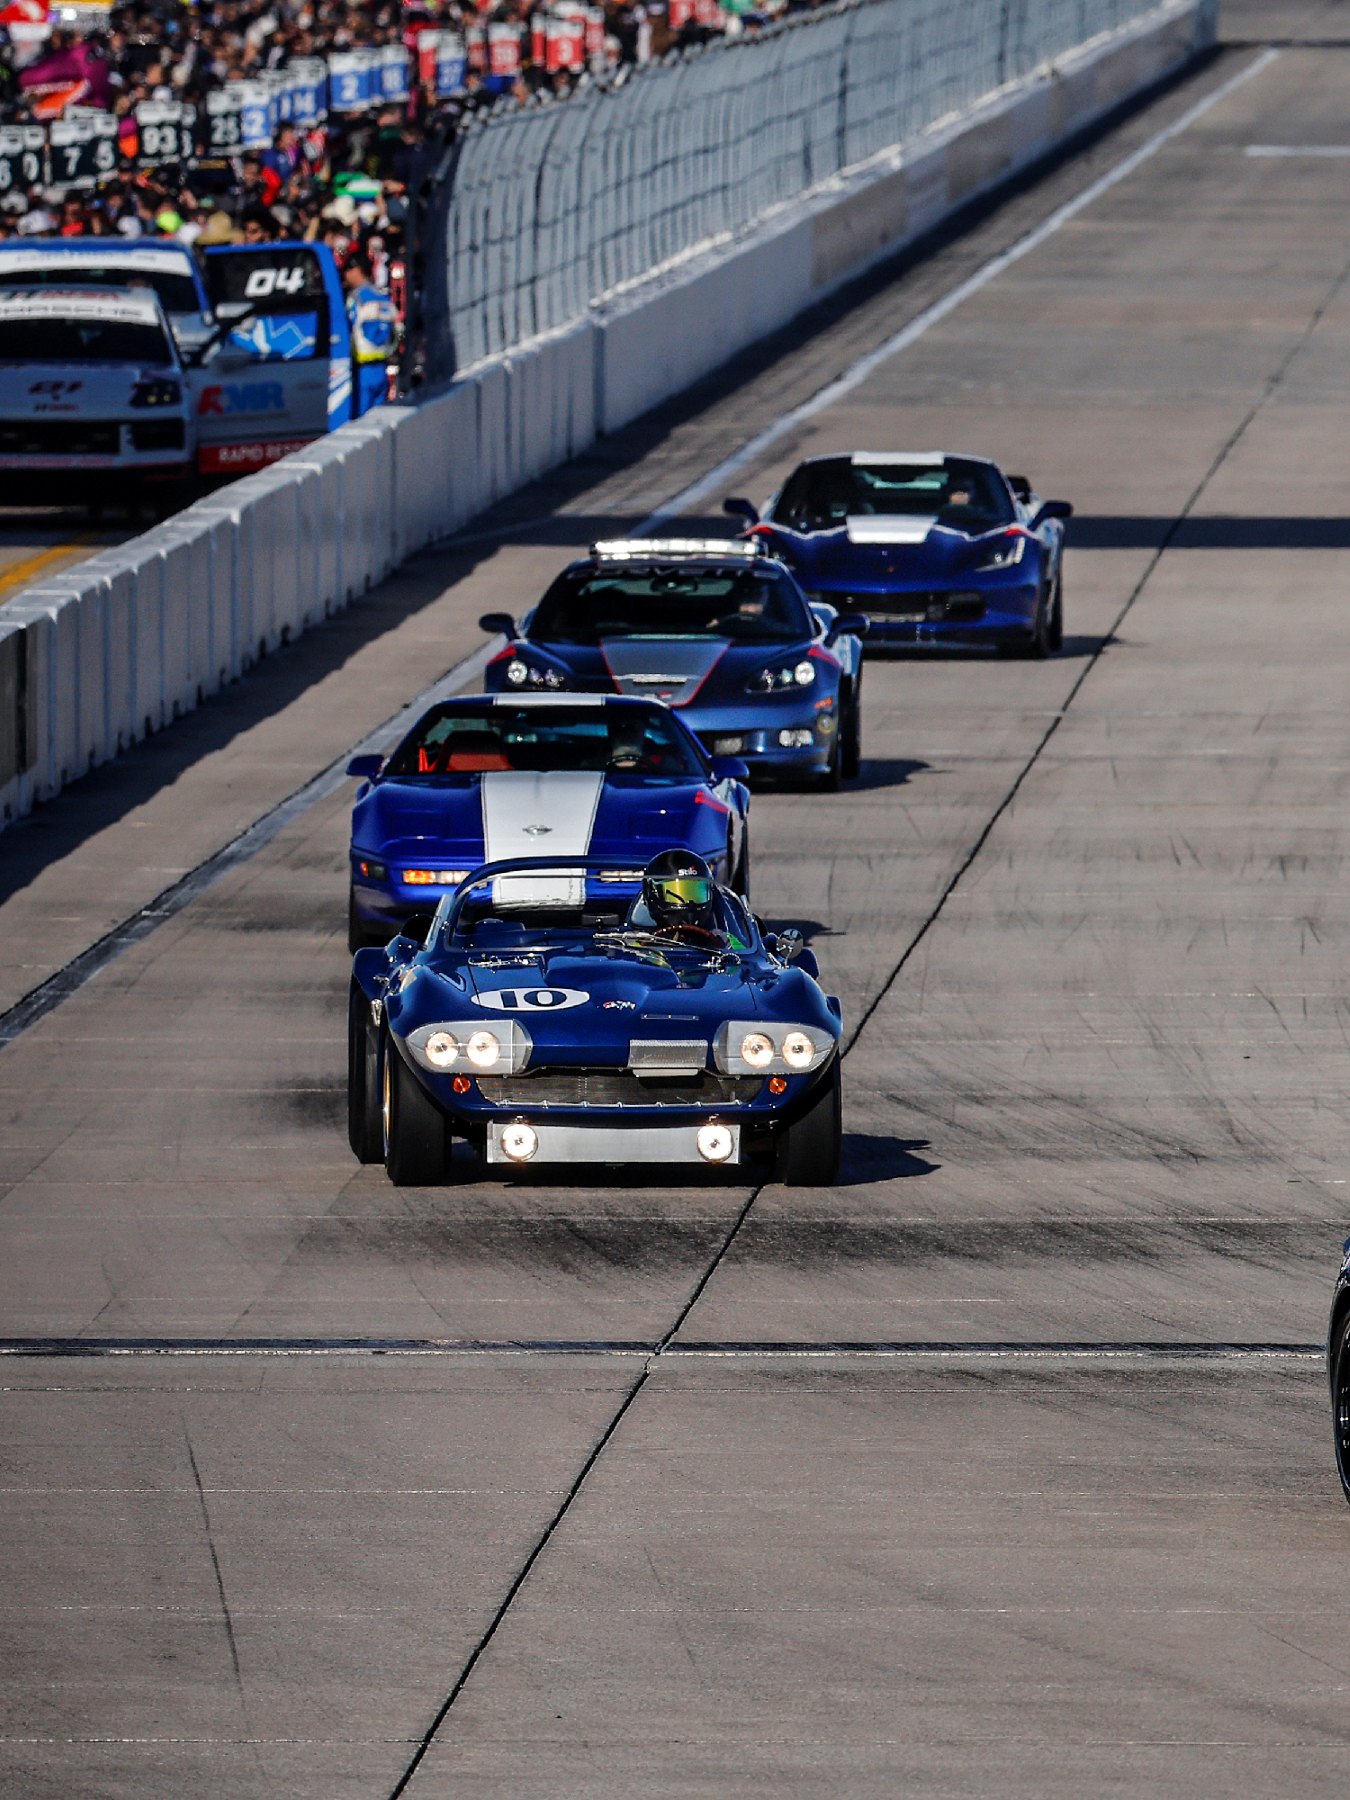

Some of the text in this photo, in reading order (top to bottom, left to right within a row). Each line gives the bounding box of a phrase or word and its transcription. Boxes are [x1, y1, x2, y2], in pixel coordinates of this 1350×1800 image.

[143, 126, 178, 155] 93
[63, 146, 82, 176] 7
[244, 267, 304, 297] 04
[0, 304, 143, 317] ORSCHE
[218, 445, 264, 463] RAPID
[501, 989, 568, 1008] 10
